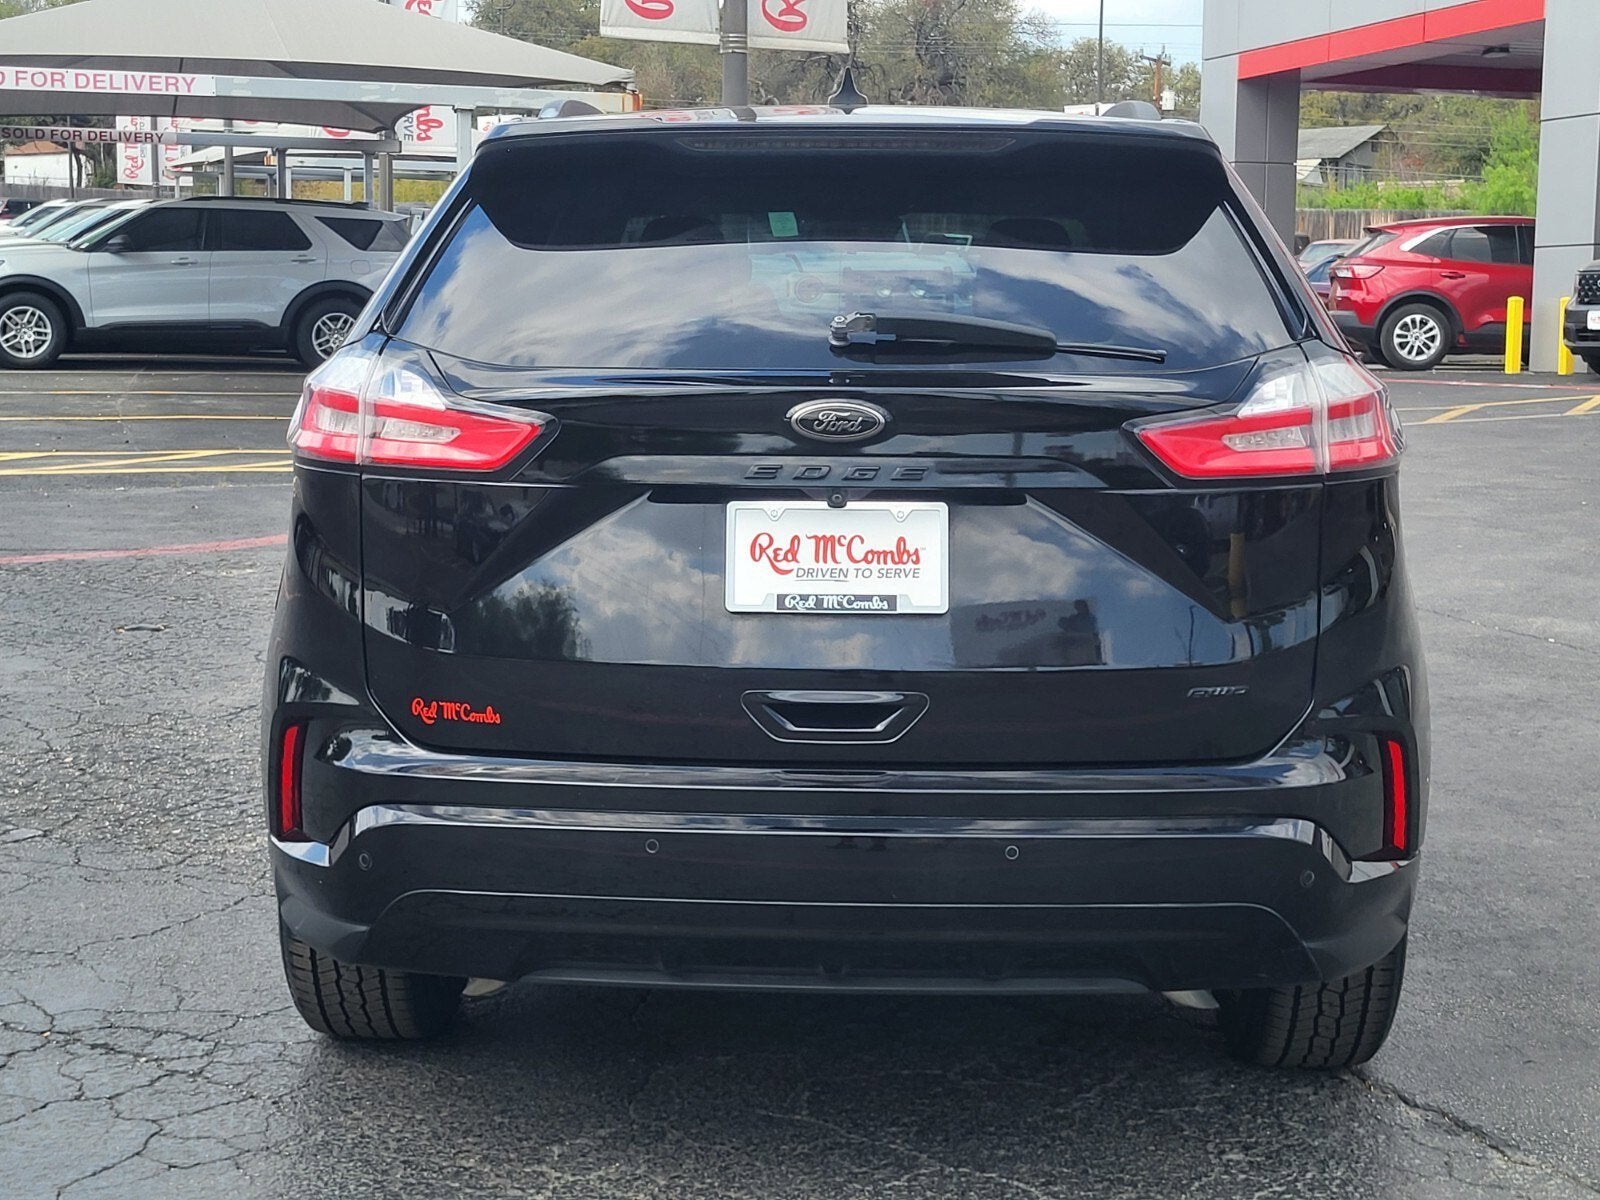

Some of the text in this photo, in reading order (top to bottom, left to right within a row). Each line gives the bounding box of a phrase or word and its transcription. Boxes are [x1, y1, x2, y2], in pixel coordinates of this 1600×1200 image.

[15, 70, 66, 89] FOR
[74, 72, 197, 93] DELIVERY
[1, 127, 164, 143] SOLD FOR DELIVERY
[813, 410, 863, 433] Ford
[743, 464, 930, 481] EDGE
[750, 532, 921, 576] Red McCombs
[795, 567, 921, 579] DRIVEN TO SERVE
[784, 594, 889, 611] Red McCombs
[411, 697, 501, 725] Red McCombs
